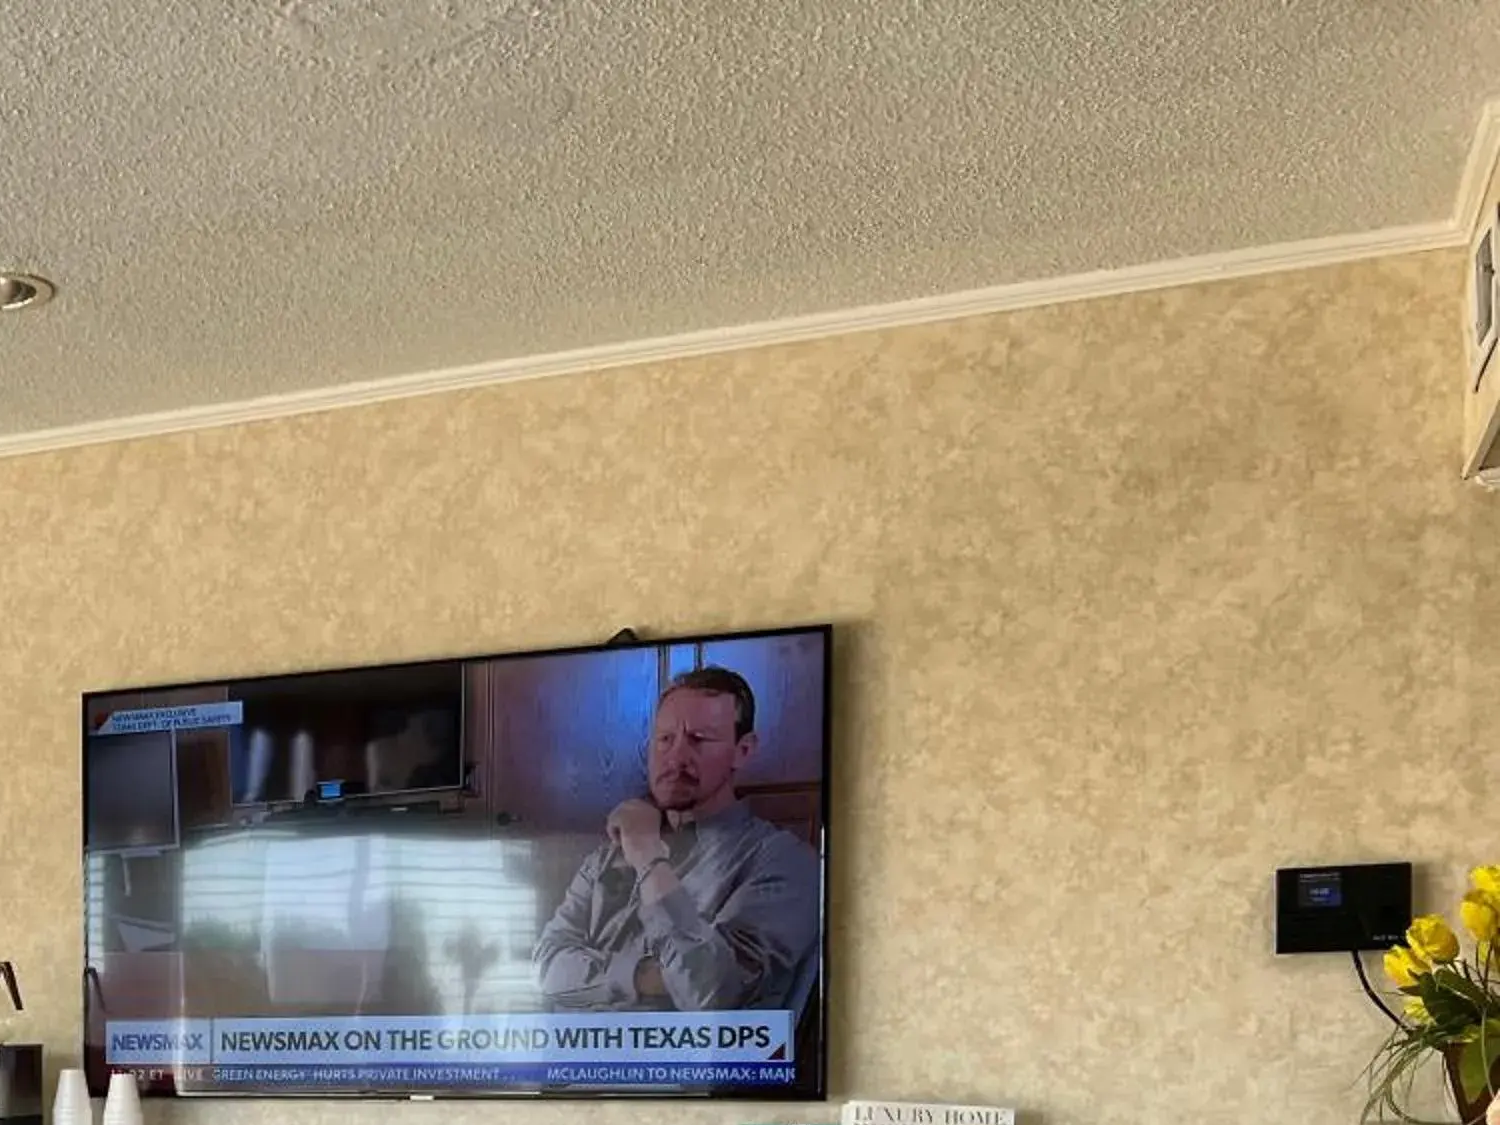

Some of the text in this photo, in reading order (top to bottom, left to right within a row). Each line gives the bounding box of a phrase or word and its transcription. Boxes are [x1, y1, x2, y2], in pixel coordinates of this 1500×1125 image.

[111, 1033, 204, 1051] NEWSMAX
[221, 1026, 771, 1051] NEWSMAX ON THE GROUND WITH TEXAS DPS
[548, 1067, 647, 1081] MCLAUGHLIN
[649, 1068, 665, 1080] TO
[670, 1067, 757, 1080] NEWSMAX:
[854, 1105, 934, 1125] LUXURY
